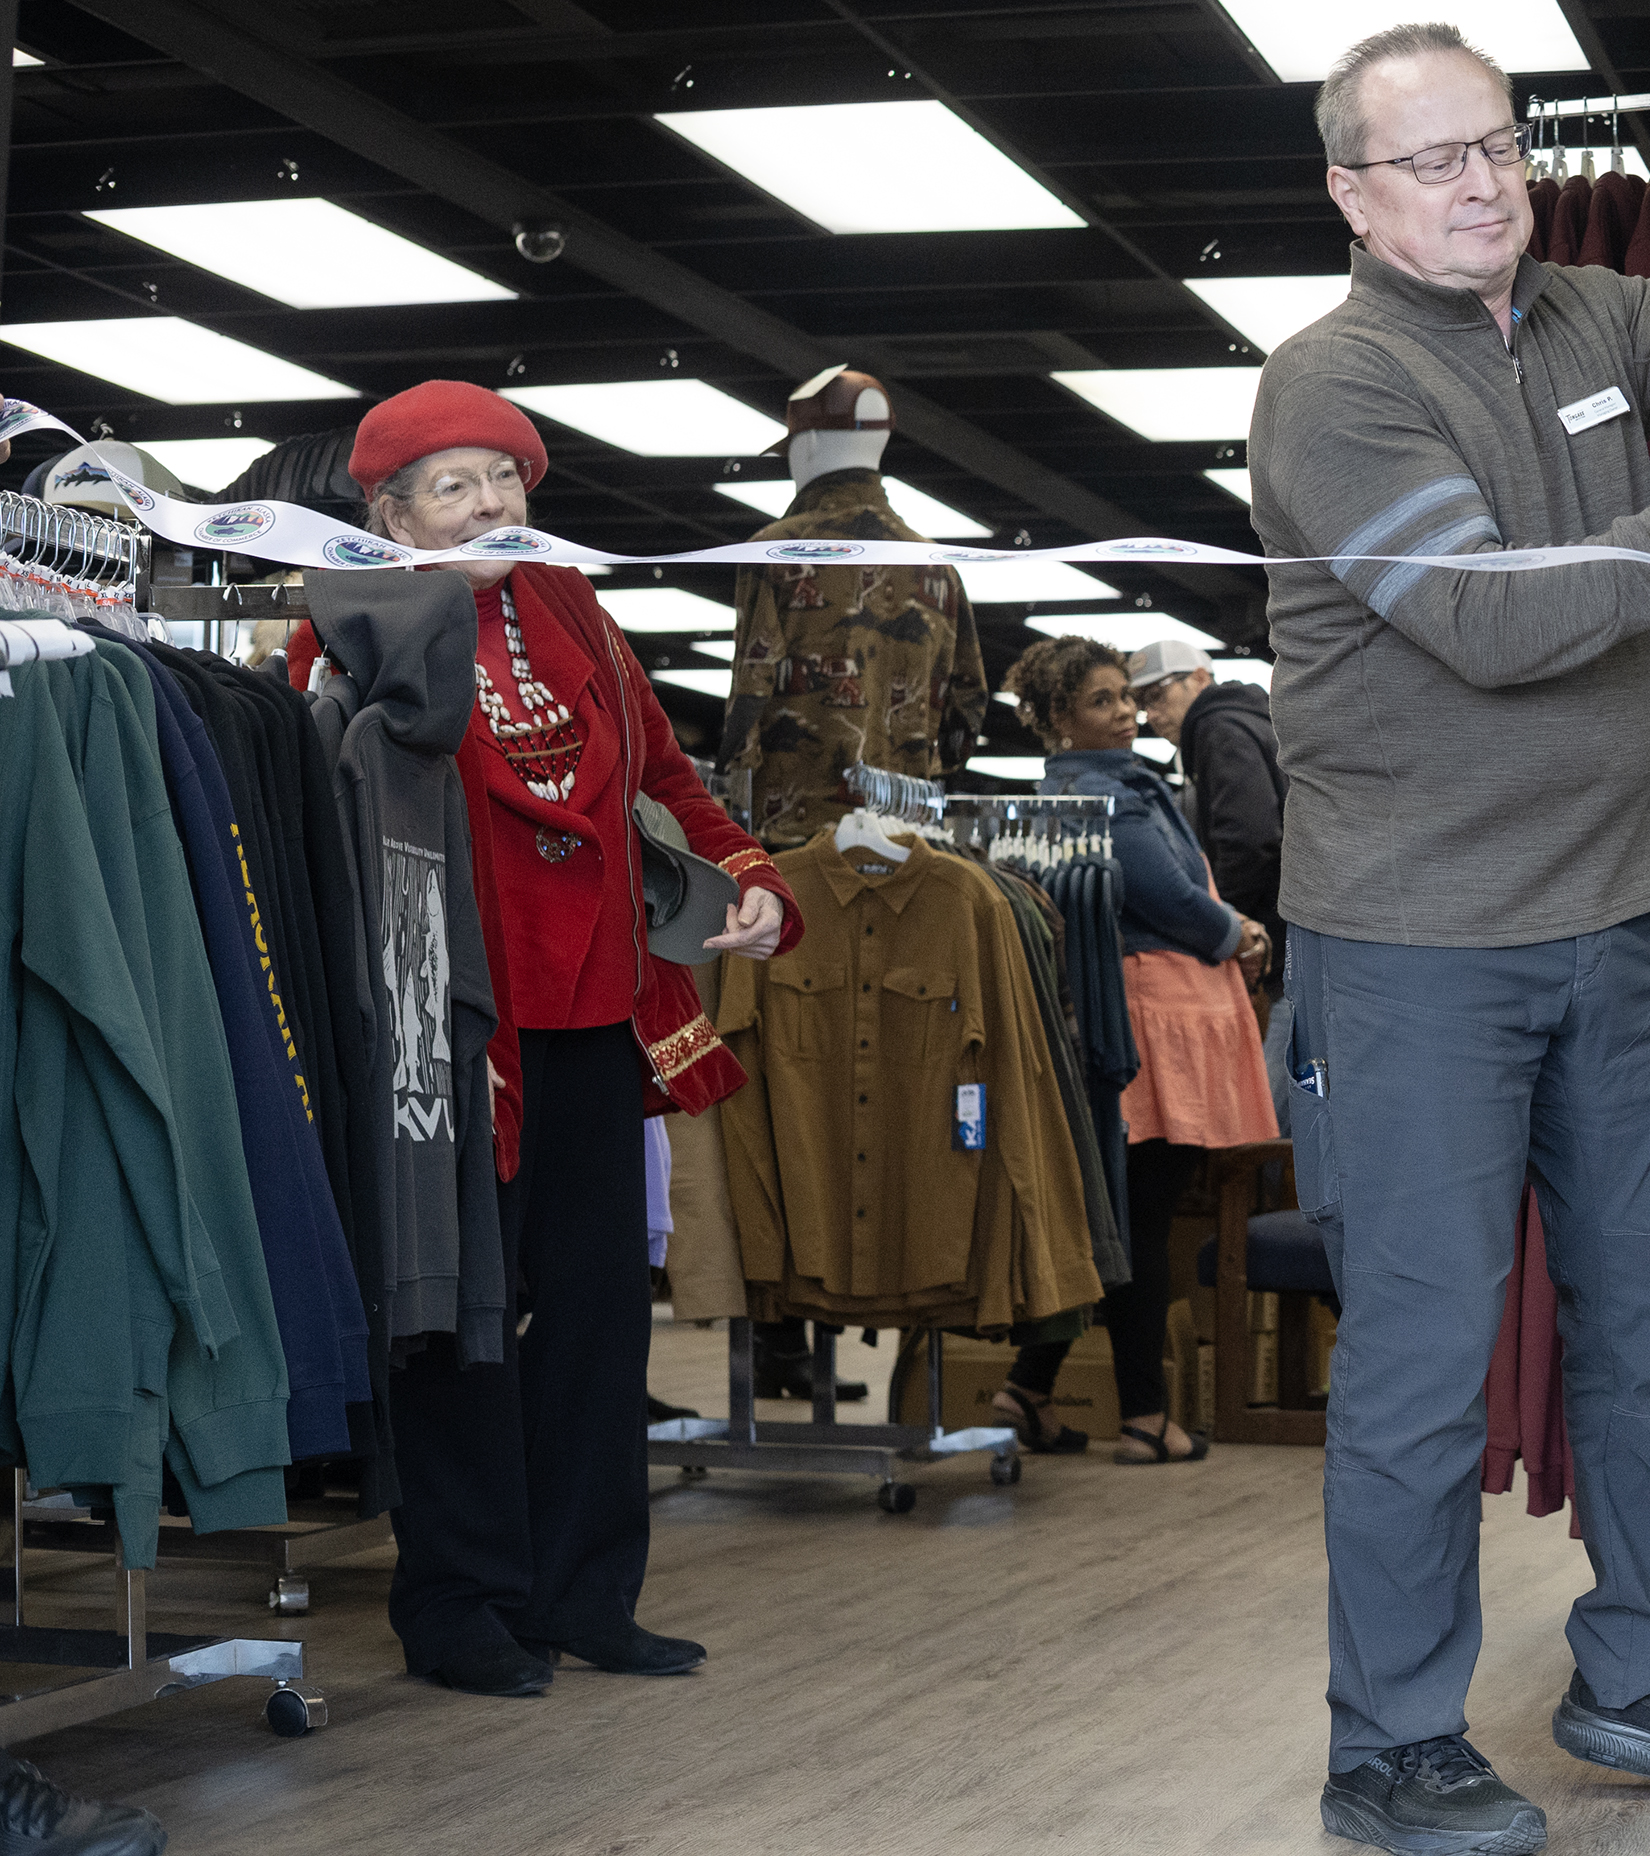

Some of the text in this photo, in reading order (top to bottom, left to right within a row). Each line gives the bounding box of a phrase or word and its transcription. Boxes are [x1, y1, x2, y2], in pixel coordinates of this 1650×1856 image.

[1592, 399, 1607, 408] Chris
[255, 507, 272, 525] ALASKA
[222, 530, 262, 543] COMMERCE
